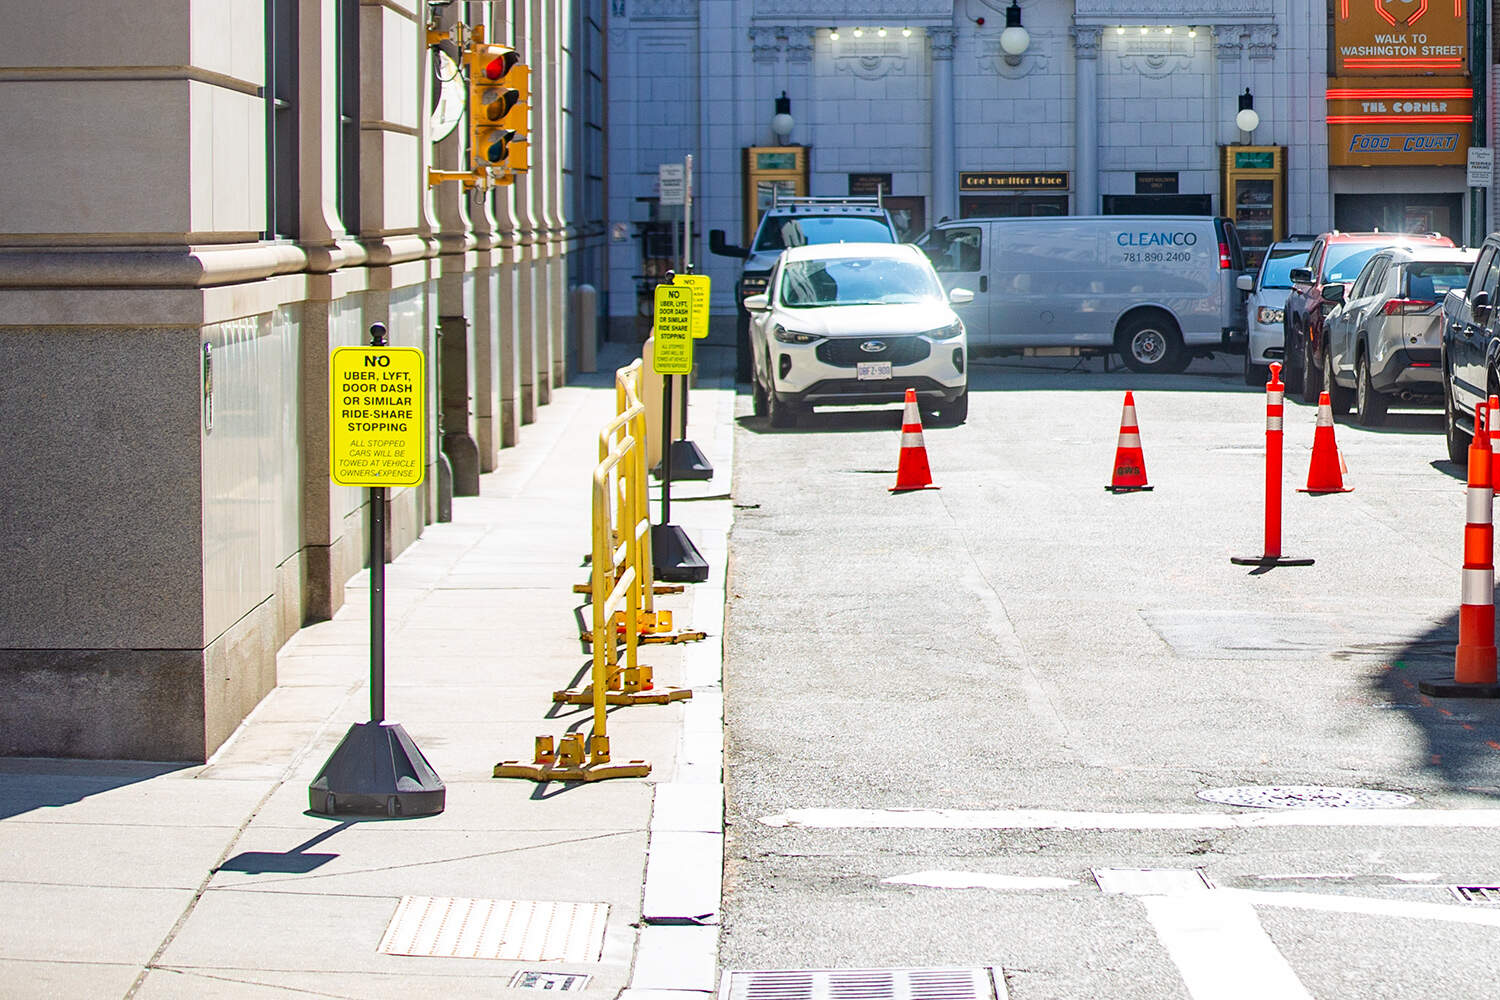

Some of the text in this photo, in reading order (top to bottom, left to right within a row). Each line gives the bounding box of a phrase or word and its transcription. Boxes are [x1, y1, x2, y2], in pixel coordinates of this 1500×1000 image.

[1374, 33, 1427, 44] WALK TO
[1340, 45, 1464, 56] WASHINGTON STREET
[1361, 102, 1448, 113] THE CORNER
[1349, 134, 1391, 152] FOOD
[966, 176, 1062, 185] One Hamilton Place
[1117, 232, 1197, 246] CLEANCO
[1123, 252, 1191, 263] 781.890.2400
[668, 290, 680, 299] NO
[364, 355, 390, 367] NO
[343, 371, 411, 382] UBER, LYFT,
[342, 384, 412, 393] DOOR DASH
[343, 397, 412, 406] OR SIMILAR
[342, 410, 413, 419] RIDE-SHARE
[347, 423, 408, 432] STOPPING
[339, 459, 416, 467] TOWED AT VEHICLE
[340, 469, 375, 477] OWNERS
